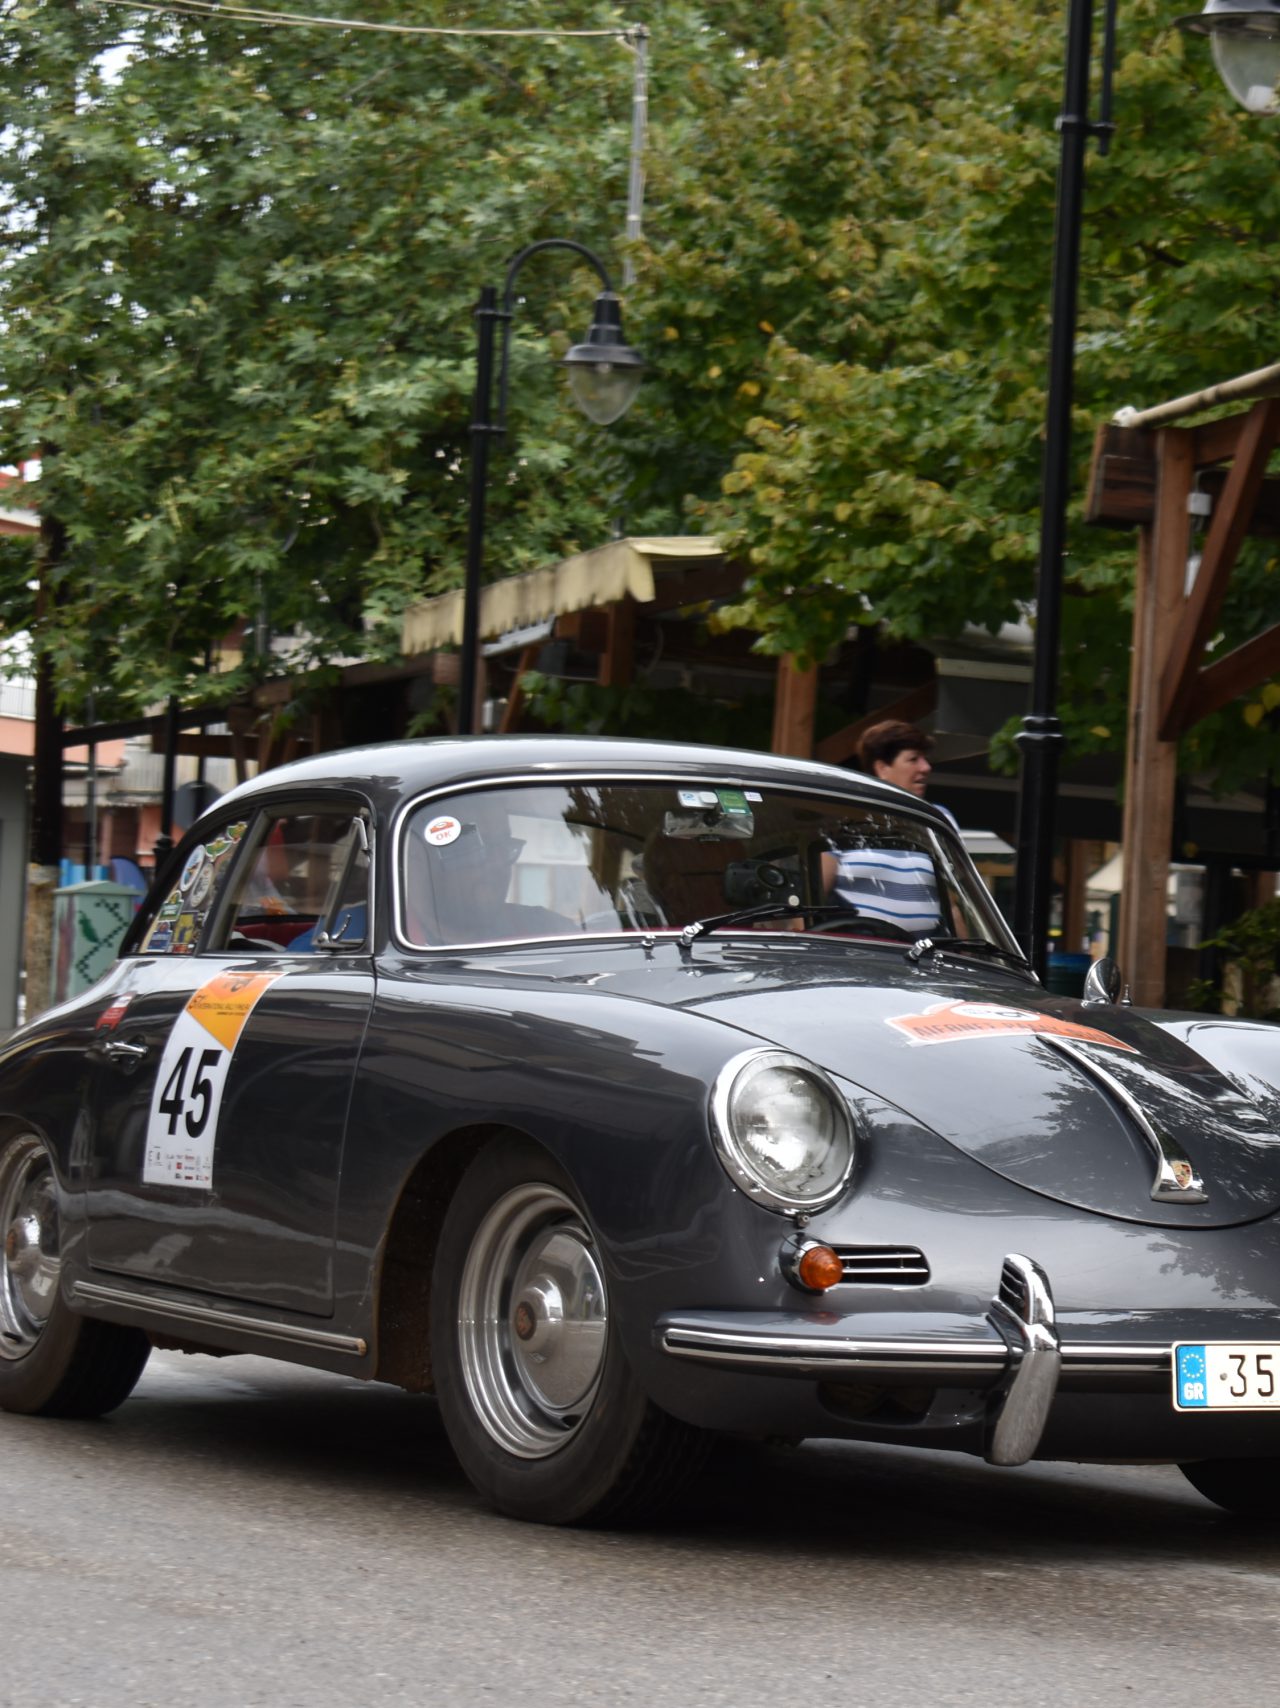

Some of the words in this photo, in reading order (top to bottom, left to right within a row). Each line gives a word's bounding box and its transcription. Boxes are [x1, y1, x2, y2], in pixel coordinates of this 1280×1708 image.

[435, 830, 452, 841] OK
[158, 1047, 222, 1138] 45
[1183, 1382, 1204, 1400] GR
